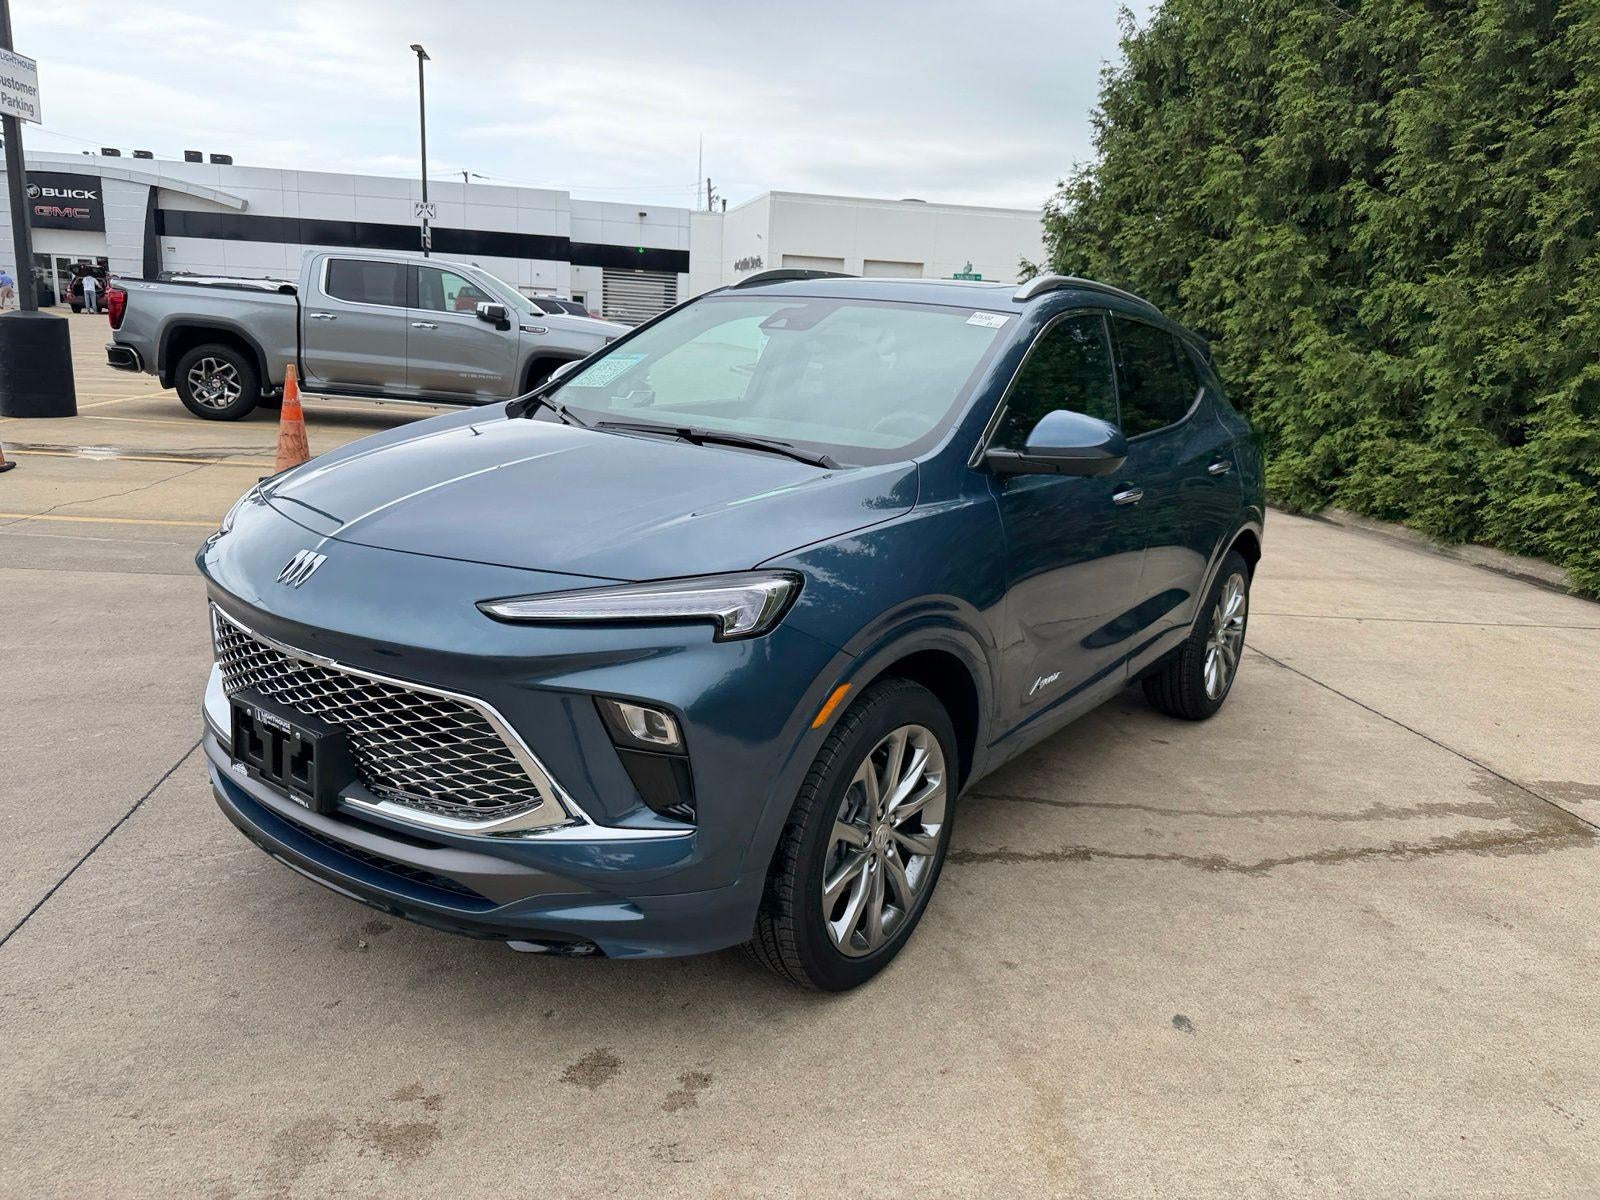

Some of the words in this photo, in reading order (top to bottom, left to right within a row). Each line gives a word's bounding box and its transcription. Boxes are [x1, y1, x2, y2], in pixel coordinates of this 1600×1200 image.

[0, 75, 36, 96] ustomer
[1, 91, 35, 117] Parking
[42, 187, 98, 200] BUICK
[34, 205, 91, 218] GMC
